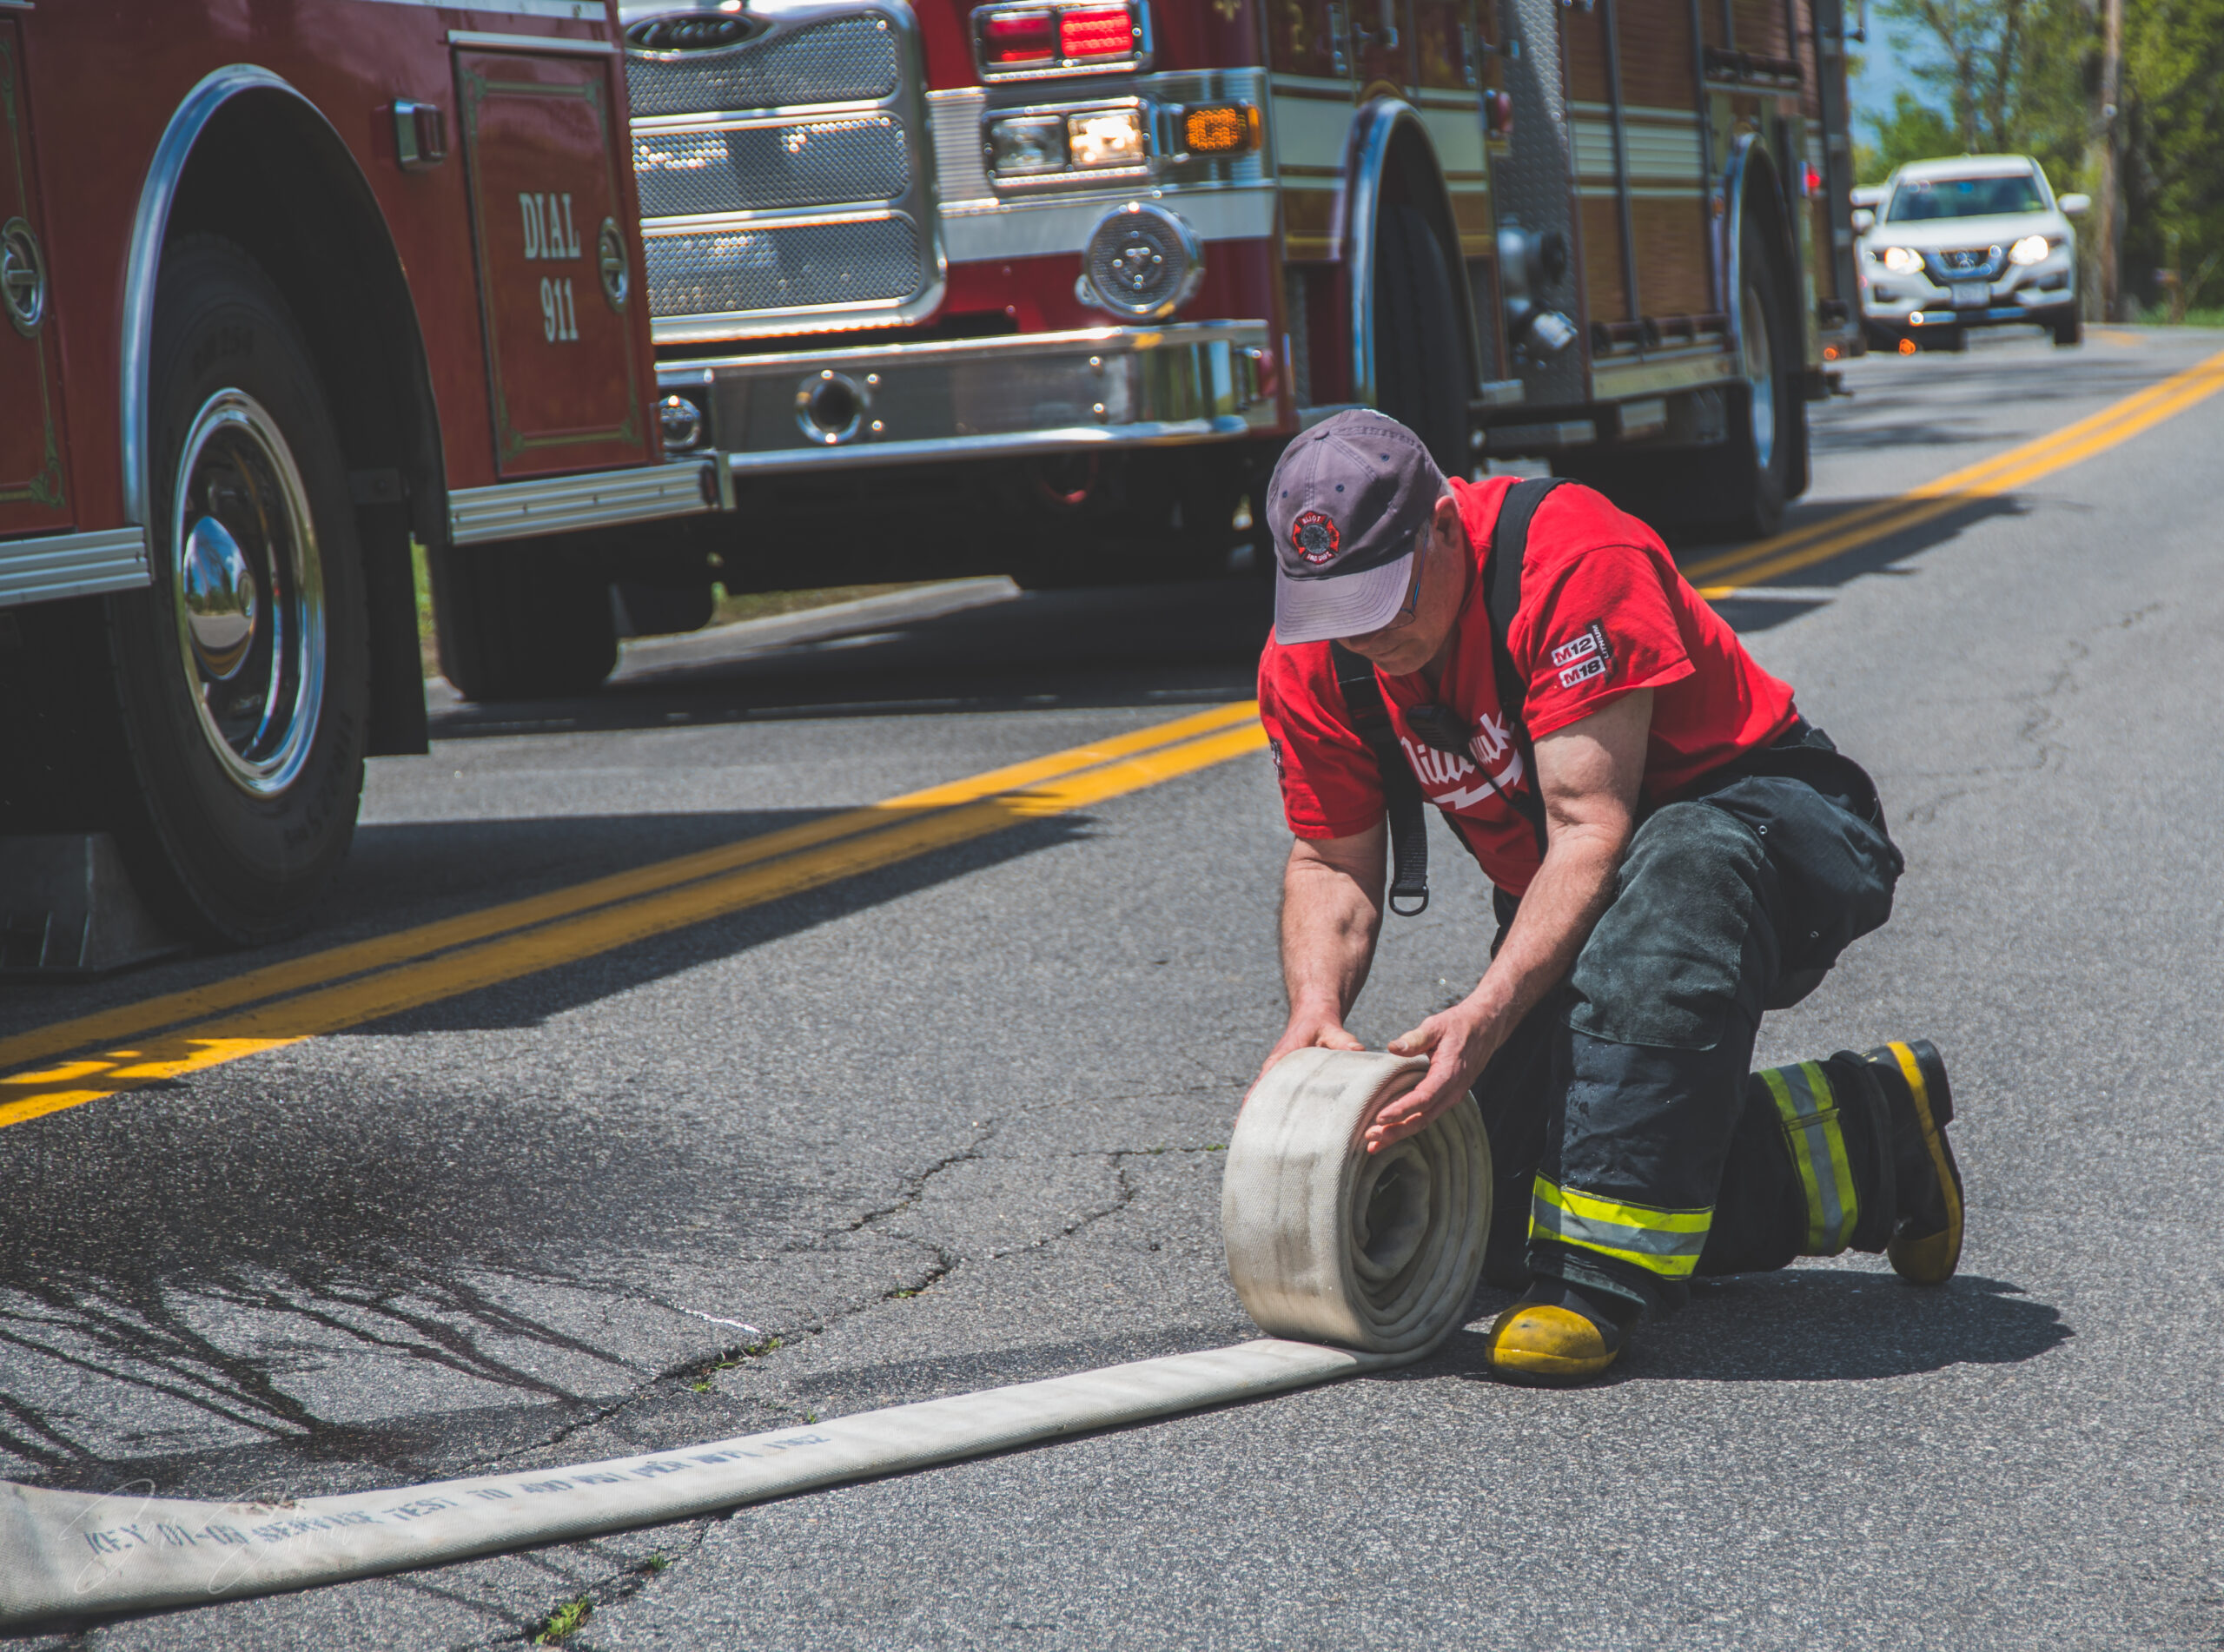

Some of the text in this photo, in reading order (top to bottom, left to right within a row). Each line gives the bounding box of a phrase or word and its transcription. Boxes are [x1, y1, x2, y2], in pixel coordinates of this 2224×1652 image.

[519, 192, 581, 260] DIAL
[540, 276, 579, 343] 911
[1554, 637, 1593, 664] M12
[1592, 624, 1610, 659] LITHIUM
[1563, 659, 1601, 684] M18
[381, 1497, 459, 1521] TEST
[466, 1488, 514, 1501] TO
